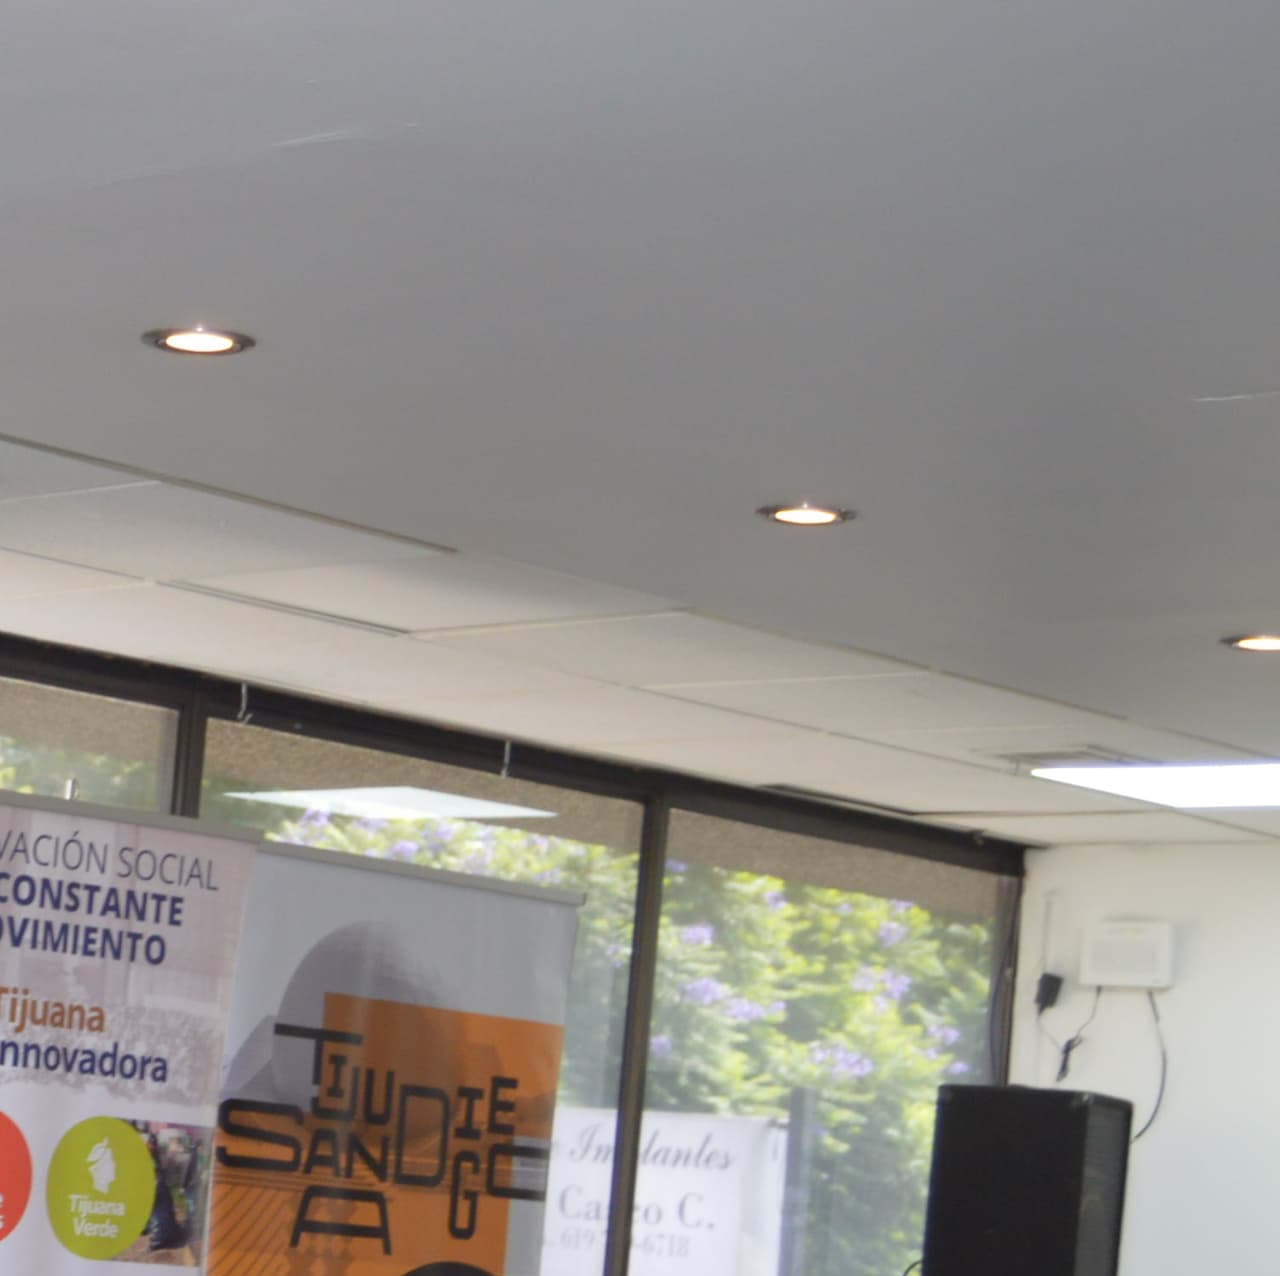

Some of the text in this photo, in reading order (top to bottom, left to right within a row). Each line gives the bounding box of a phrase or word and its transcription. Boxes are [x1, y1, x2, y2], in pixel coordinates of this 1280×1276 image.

[116, 846, 221, 891] SOCIAL
[68, 1193, 125, 1218] Tijuana
[72, 1216, 119, 1238] Verde
